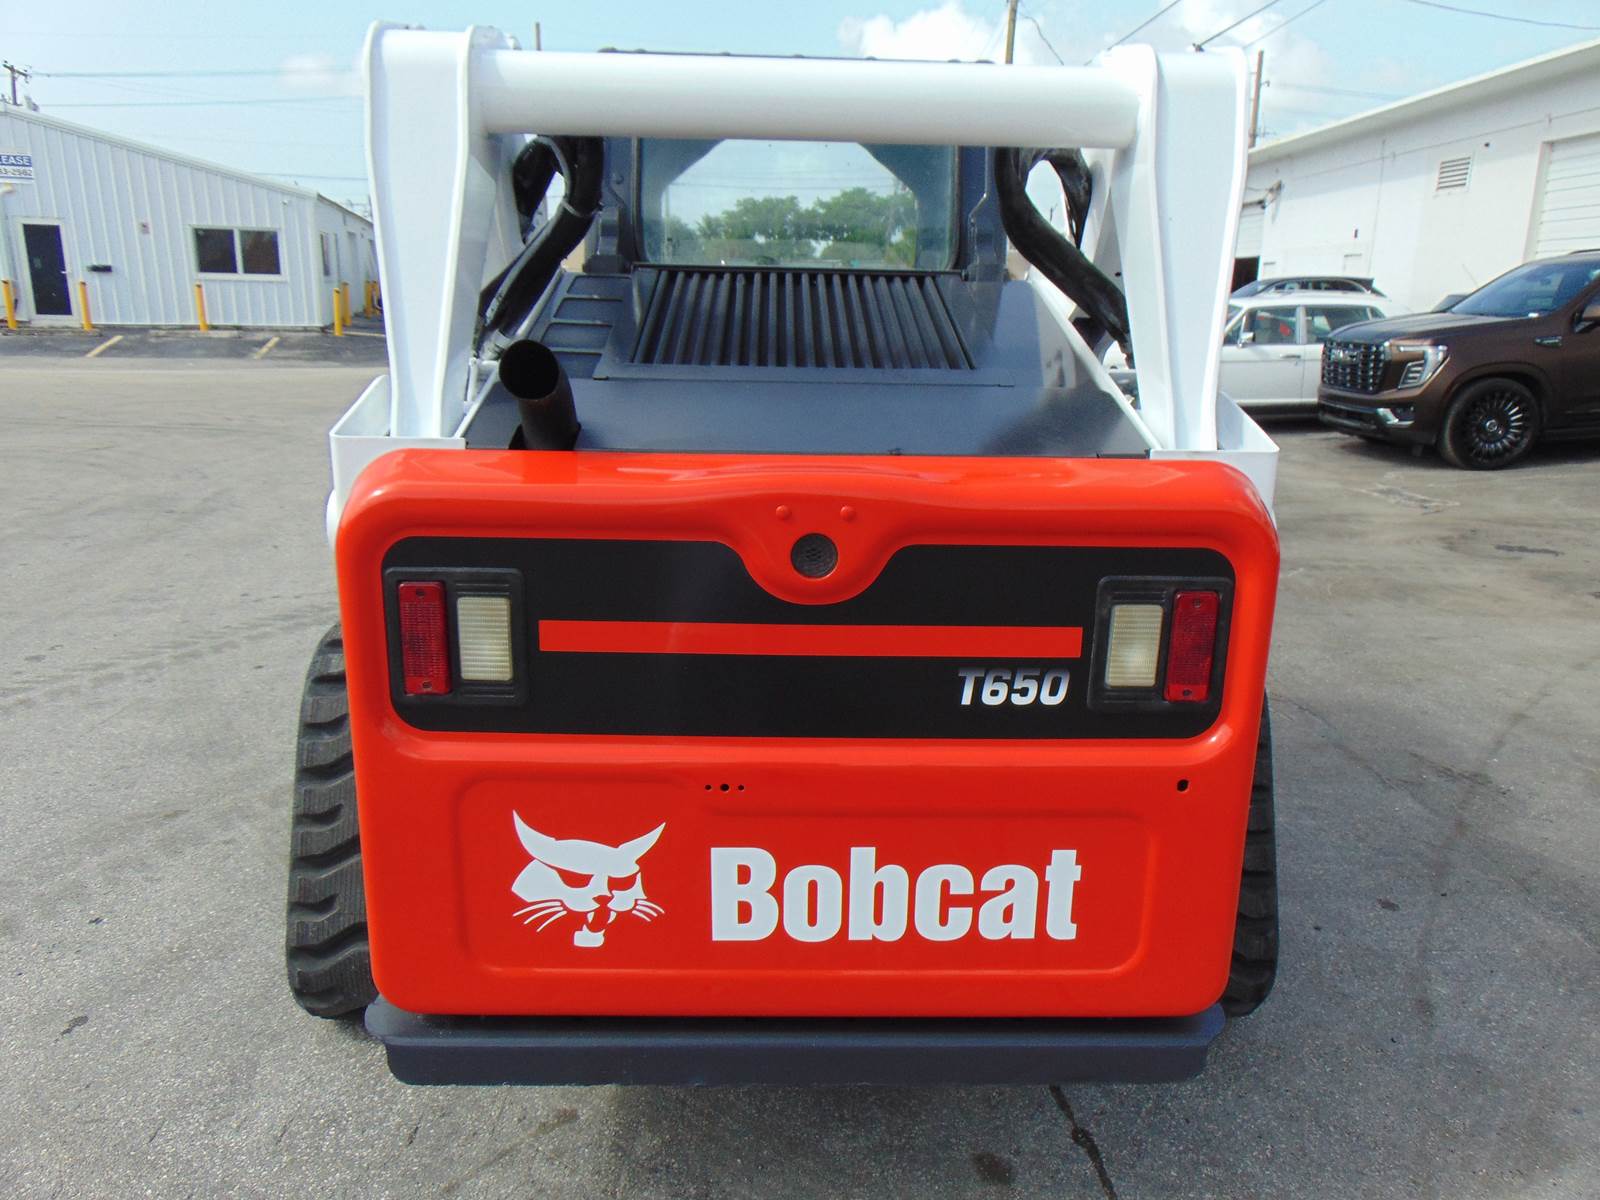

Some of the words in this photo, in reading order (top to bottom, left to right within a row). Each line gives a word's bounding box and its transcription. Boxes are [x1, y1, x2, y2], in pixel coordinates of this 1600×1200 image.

[0, 155, 30, 166] EASE
[959, 667, 1071, 707] T650
[710, 846, 1082, 943] Bobcat
